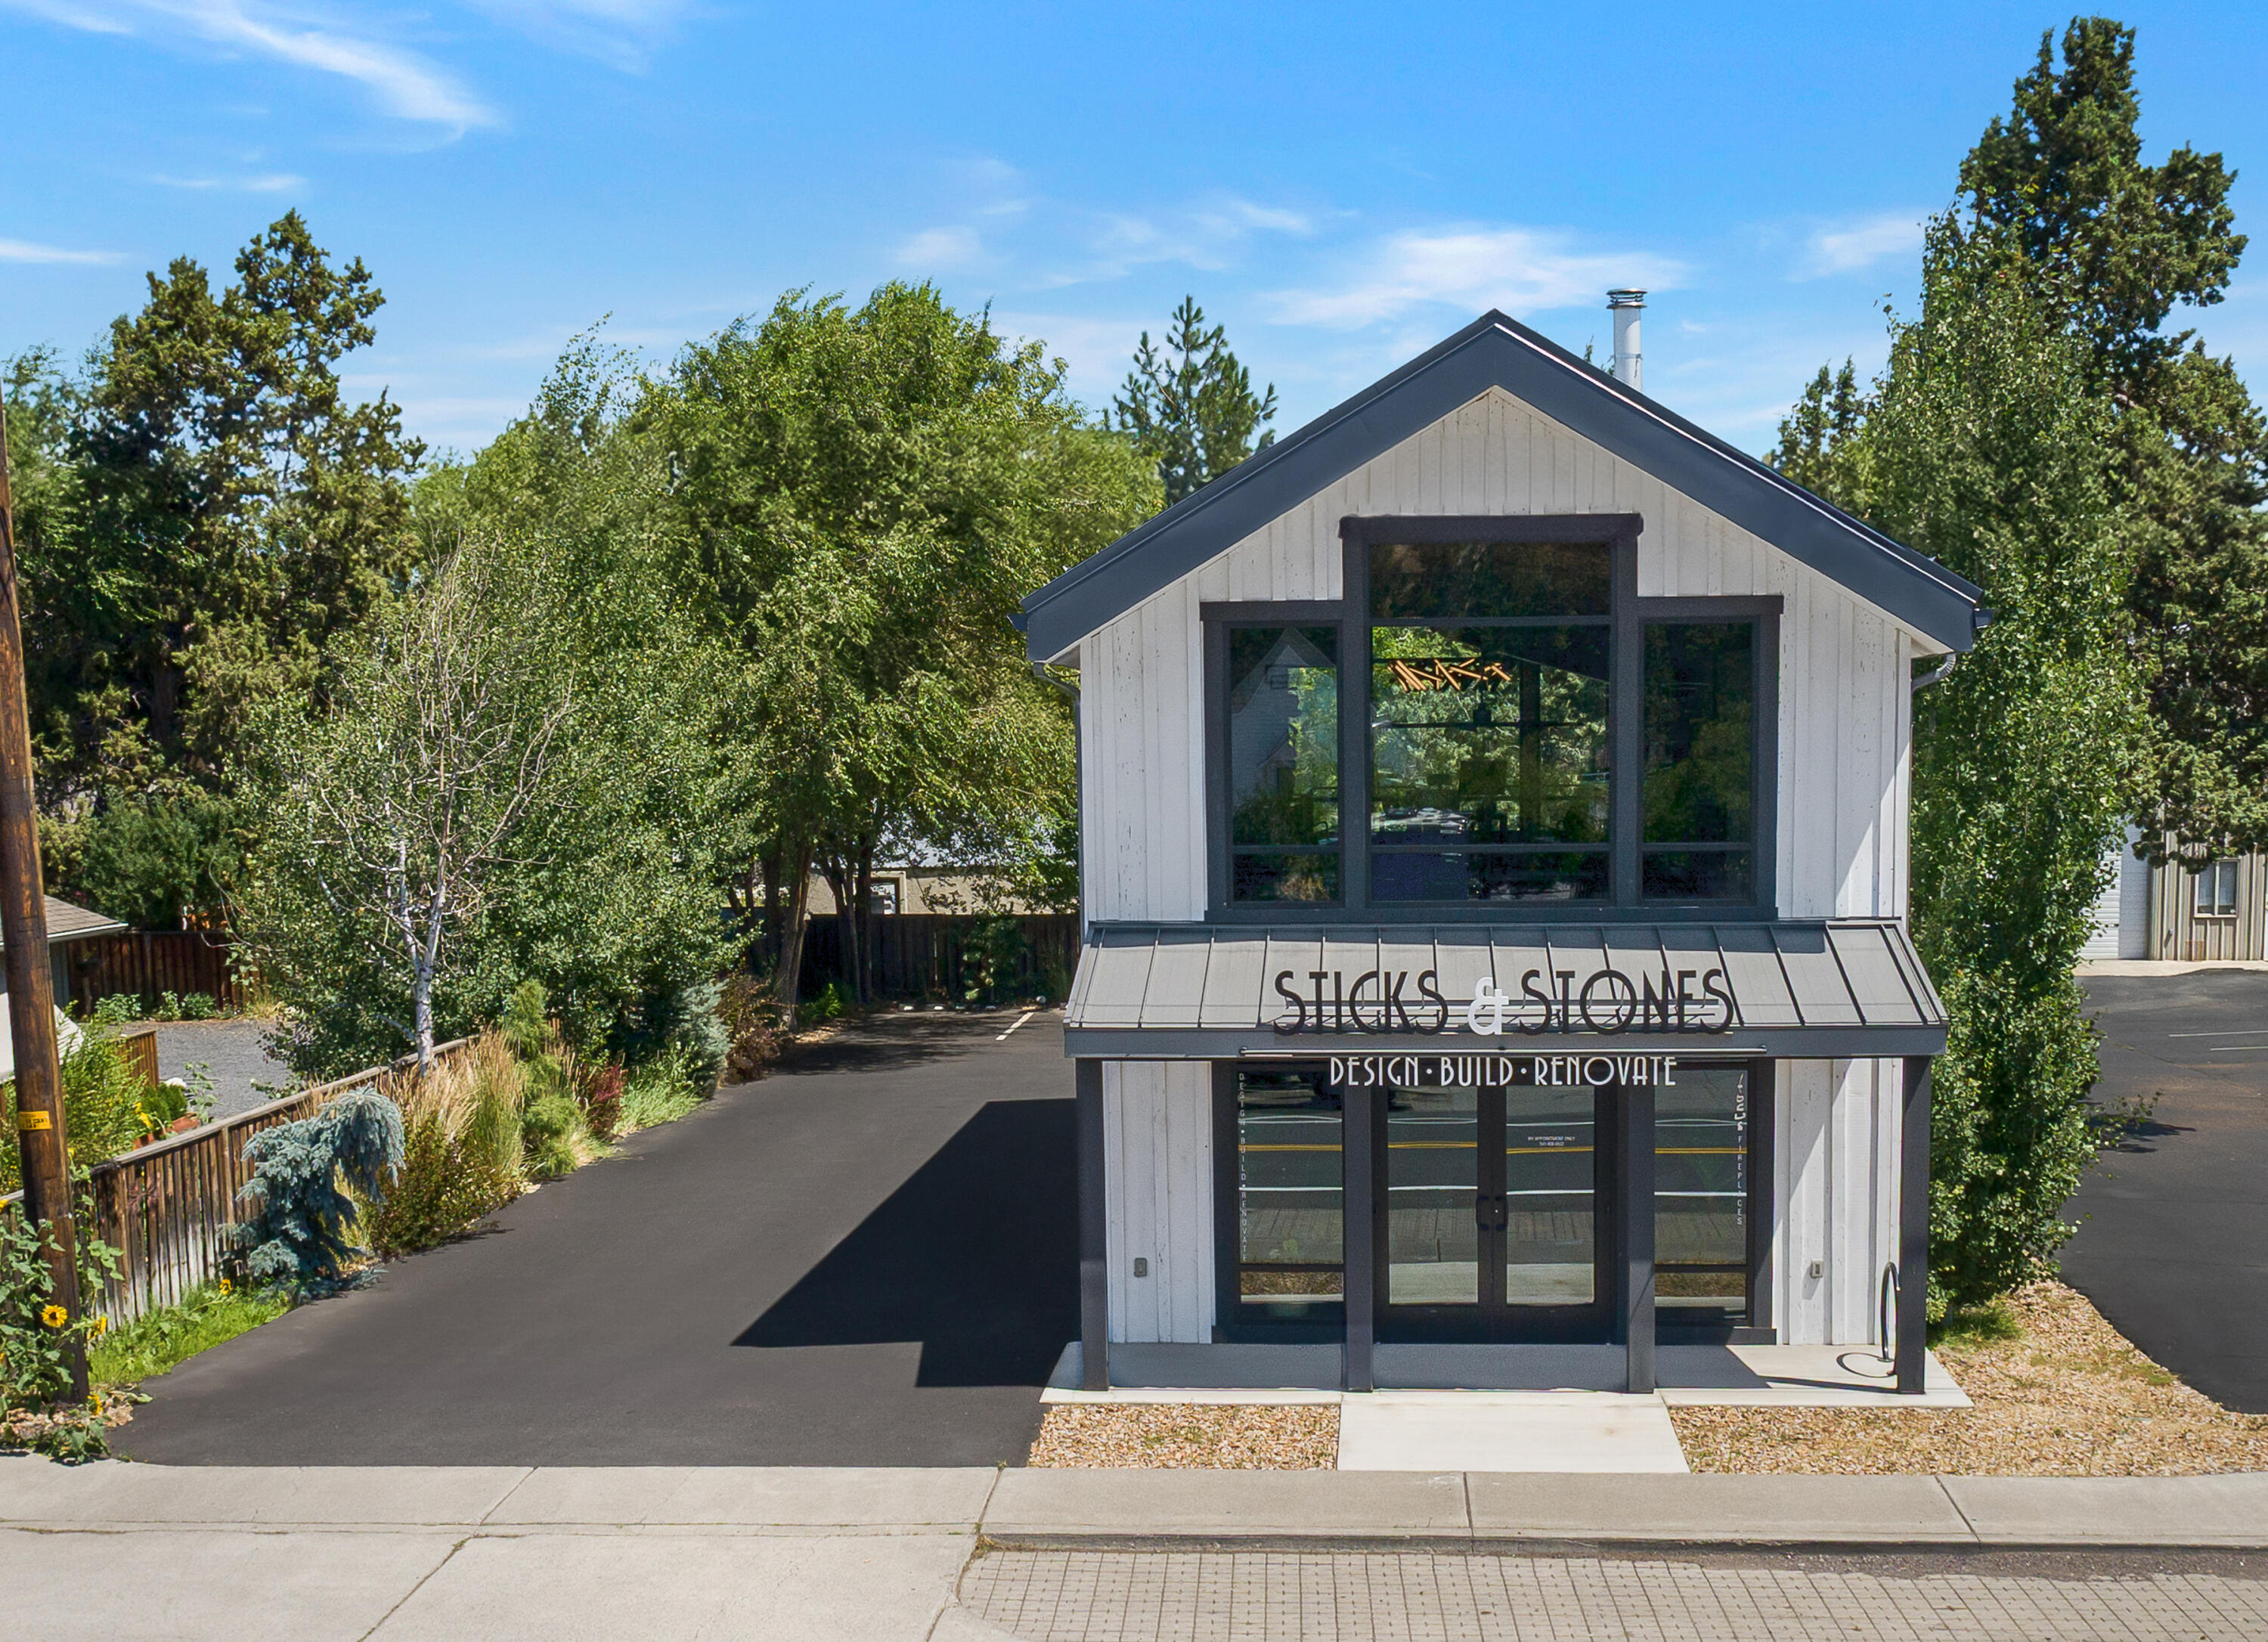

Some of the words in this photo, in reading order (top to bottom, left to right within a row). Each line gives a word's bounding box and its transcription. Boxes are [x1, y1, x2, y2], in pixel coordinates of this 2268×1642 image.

[1273, 970, 1448, 1036] STICKS
[1468, 977, 1509, 1036] &
[1520, 968, 1734, 1036] STONES
[1330, 1057, 1418, 1086] DESIGN
[1441, 1057, 1514, 1086] BUILD
[1535, 1056, 1677, 1086] RENOVATE
